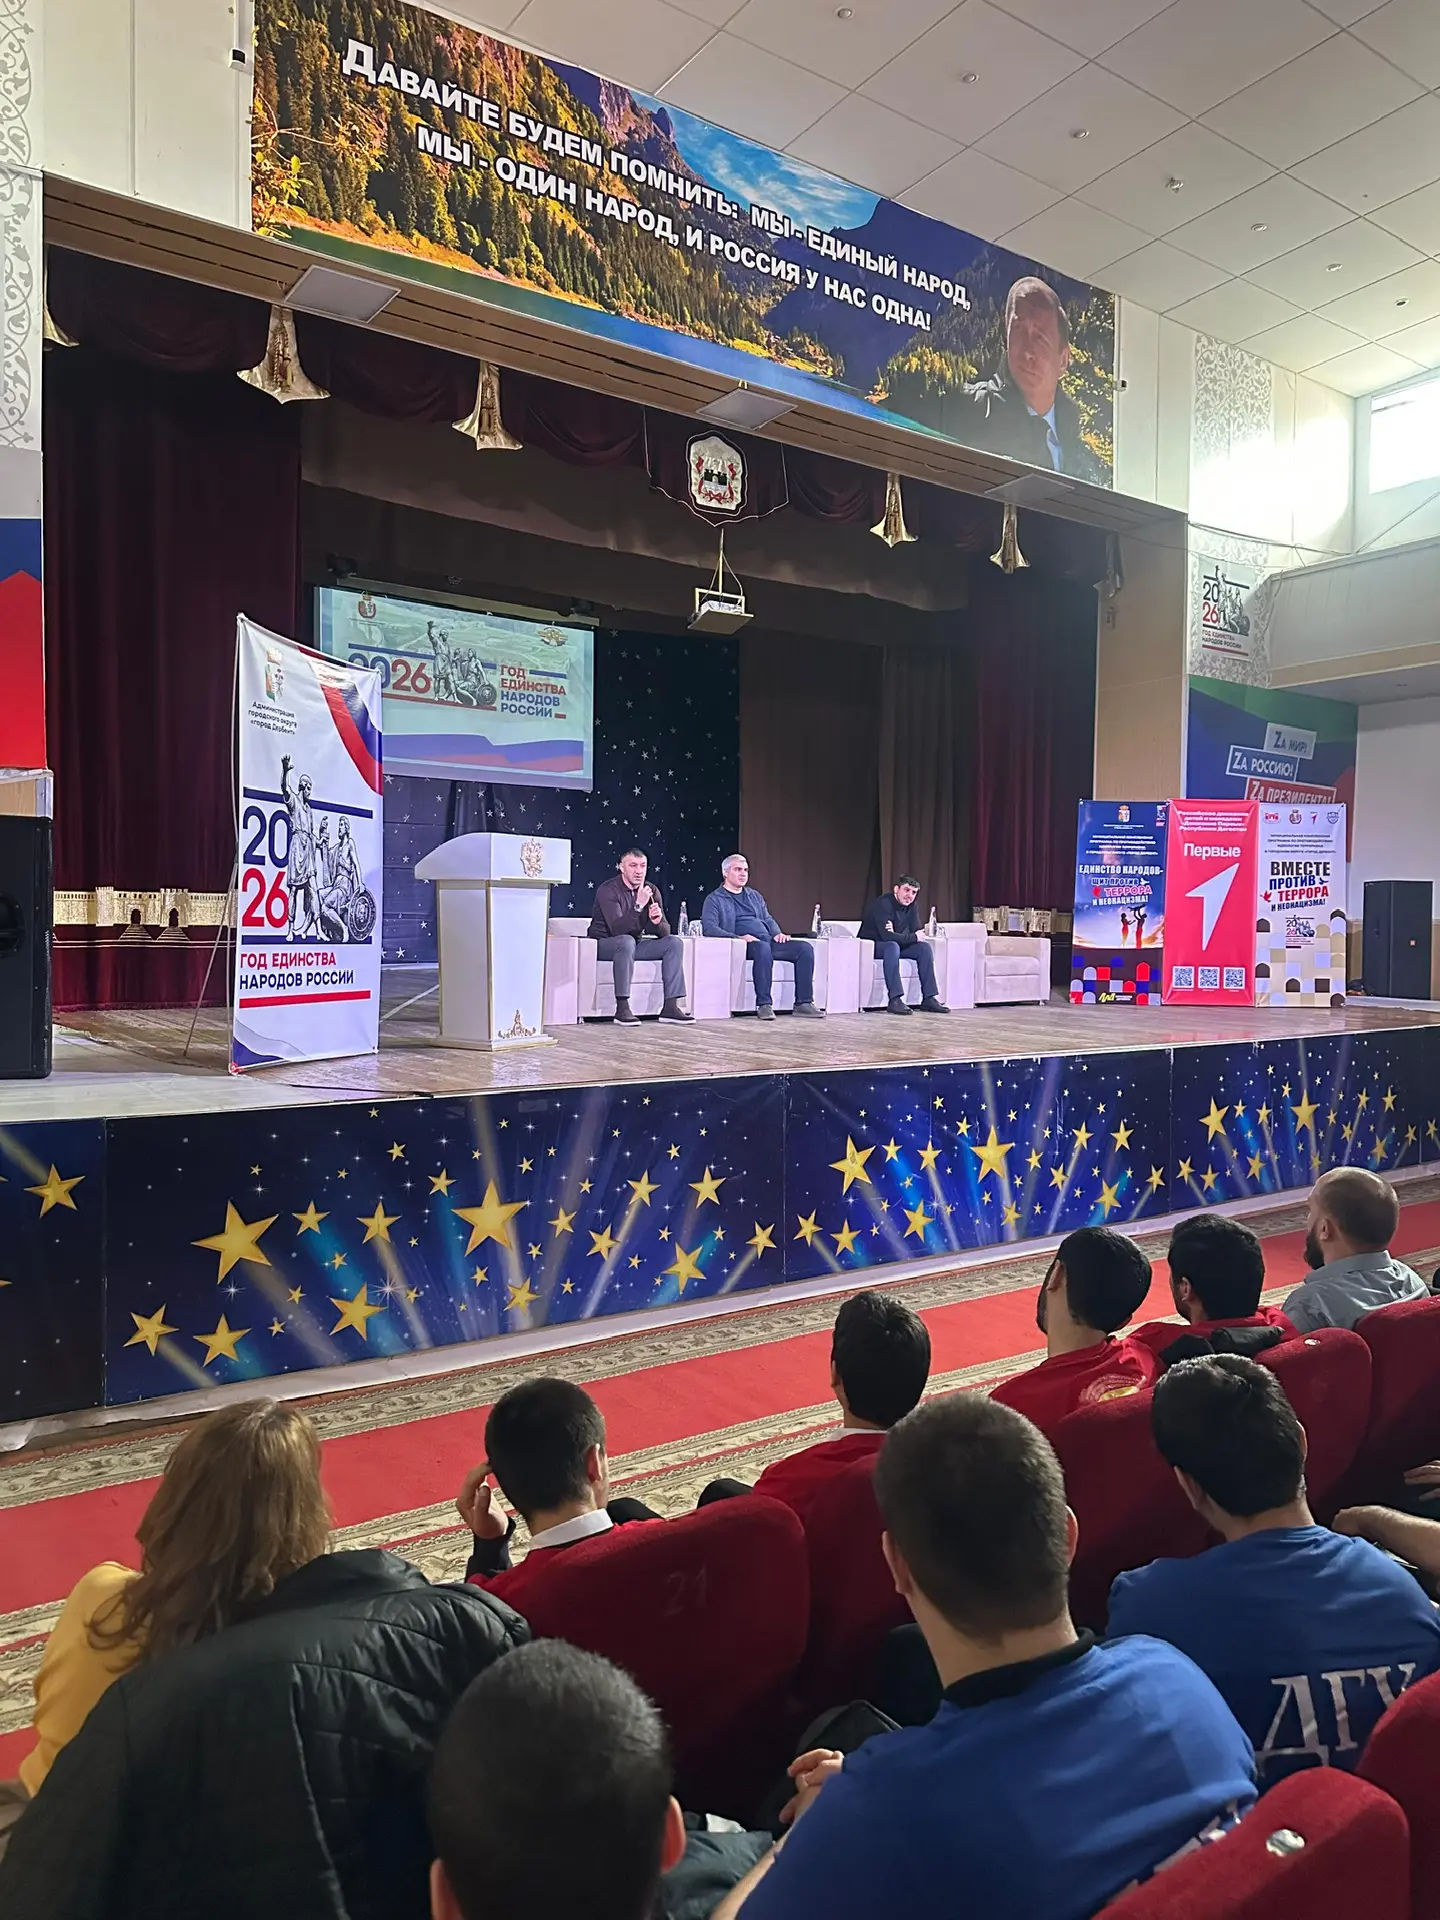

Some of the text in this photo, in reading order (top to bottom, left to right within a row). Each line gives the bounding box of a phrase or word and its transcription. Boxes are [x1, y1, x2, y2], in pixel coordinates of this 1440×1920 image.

[508, 110, 603, 167] БУДЕМ
[609, 152, 740, 220] ПОМНИТЬ:
[750, 209, 791, 238] МЫ
[807, 226, 898, 281] ЕДИНЫЙ
[902, 266, 972, 312] НАРОД,
[417, 126, 472, 164] МЫ
[495, 158, 578, 206] ОДИН
[585, 188, 680, 248] НАРОД,
[685, 224, 704, 250] И
[709, 234, 802, 285] РОССИЯ
[804, 266, 821, 290] У
[824, 278, 867, 308] НАС
[871, 292, 932, 333] ОДНА!
[1203, 581, 1219, 603] 20
[1203, 601, 1219, 623] 26
[501, 664, 526, 680] ГОД
[501, 678, 566, 696] ЕДИНСТВА
[501, 691, 561, 708] НАРОДОВ
[501, 703, 552, 718] РОССИИ
[1251, 758, 1294, 776] РОССИЮ!
[242, 806, 291, 868] 20
[1184, 843, 1241, 860] Первые
[1079, 864, 1121, 875] ЕДИНСТВО
[1270, 861, 1330, 876] ВМЕСТЕ
[1104, 885, 1152, 897] ТЕРРОРА
[1269, 875, 1316, 890] ПРОТИВ
[242, 868, 290, 928] 26
[1277, 886, 1329, 902] ТЕРРОРА
[1271, 898, 1326, 912] И НЕОНАЦИЗМА!
[240, 952, 336, 970] ГОД ЕДИНСТВА
[239, 970, 354, 989] НАРОДОВ РОССИИ
[664, 1564, 707, 1618] 21
